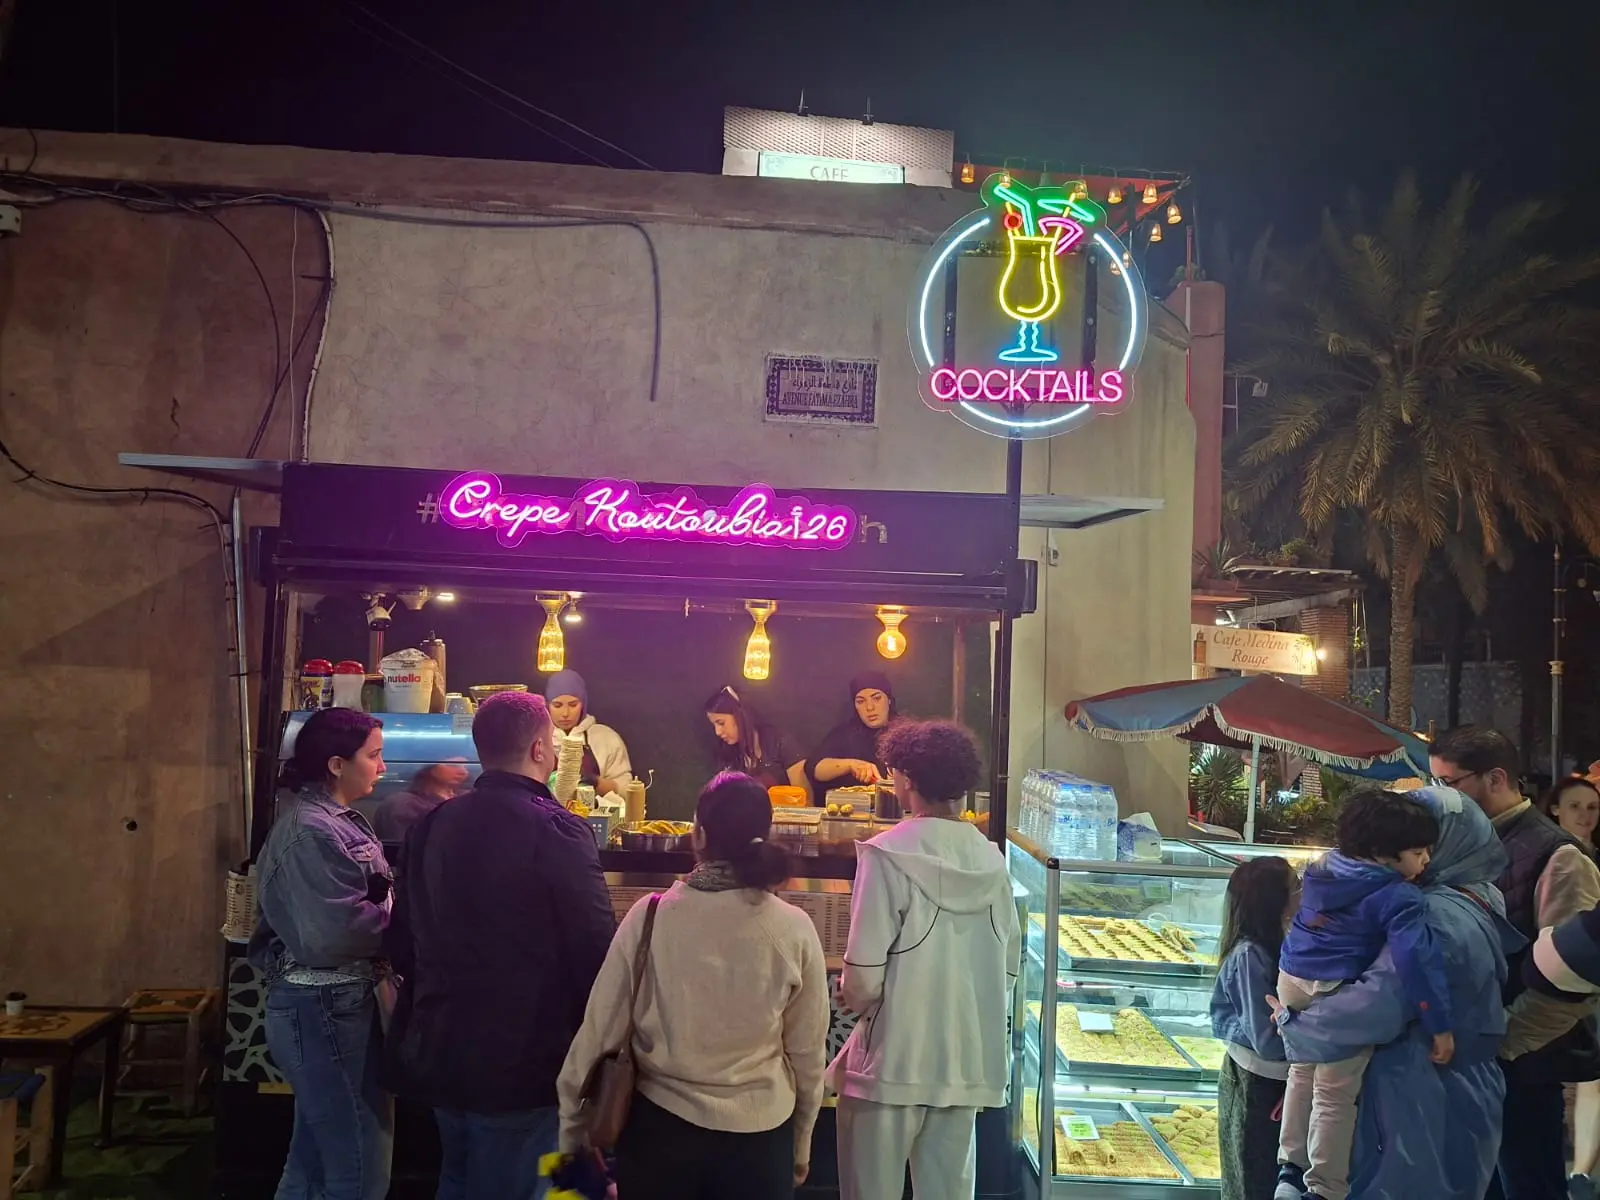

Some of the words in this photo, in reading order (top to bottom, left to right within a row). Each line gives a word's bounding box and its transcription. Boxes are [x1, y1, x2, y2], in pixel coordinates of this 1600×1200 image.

[931, 368, 1123, 402] COCKTAILS
[449, 480, 571, 538] Crepe
[1242, 630, 1289, 651] Medina
[1232, 648, 1269, 668] Rouge
[387, 672, 421, 683] nutella
